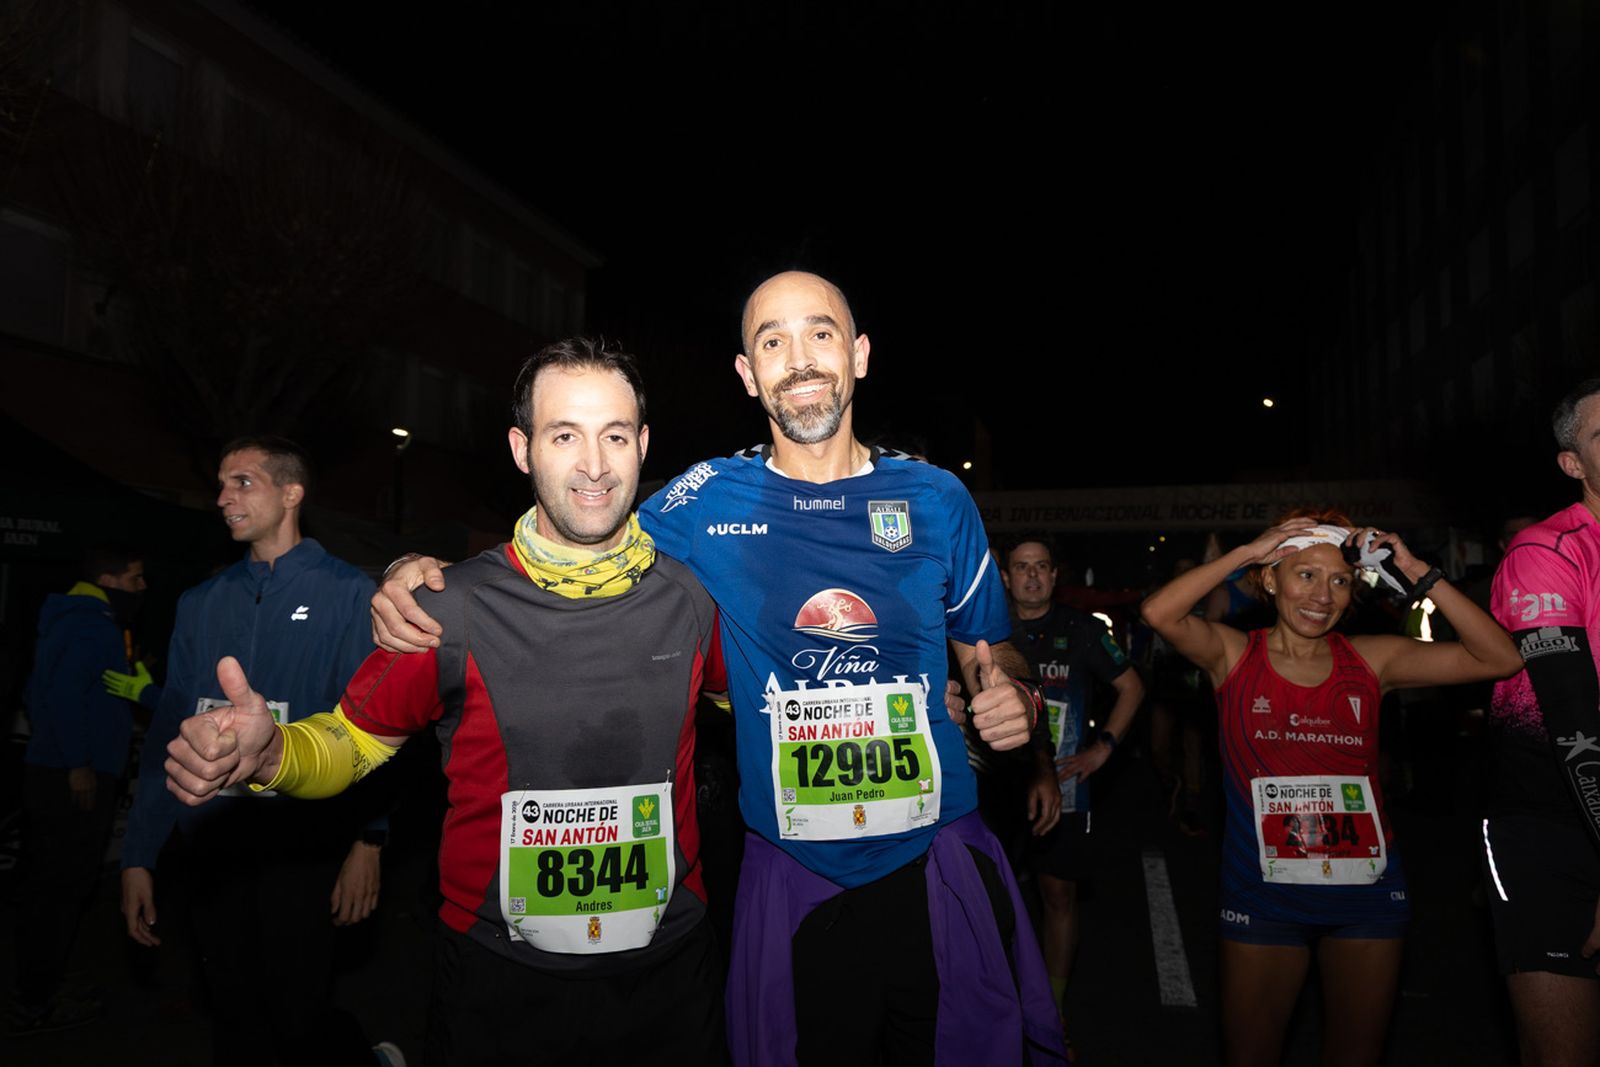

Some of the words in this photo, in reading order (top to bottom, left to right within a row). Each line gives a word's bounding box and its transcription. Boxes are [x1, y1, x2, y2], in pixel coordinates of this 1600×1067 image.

[690, 469, 719, 492] REAL
[794, 495, 845, 511] hummel
[1008, 504, 1163, 521] INTERNACIONAL
[1170, 503, 1238, 519] NOCHE
[1241, 502, 1268, 519] DE
[717, 523, 768, 535] UCLM
[791, 644, 880, 680] Viña
[786, 703, 800, 715] 43
[804, 704, 851, 720] NOCHE
[855, 703, 873, 717] DE
[788, 725, 817, 741] SAN
[820, 717, 875, 740] ANTÓN
[1254, 730, 1281, 740] A.D.
[1285, 731, 1363, 746] MARATHON
[791, 737, 920, 788] 12905
[830, 790, 854, 802] Juan
[857, 789, 885, 801] Pedro
[1280, 788, 1317, 799] NOCHE
[1319, 788, 1332, 798] DE
[523, 805, 539, 817] 43
[1268, 801, 1292, 812] SAN
[543, 808, 596, 824] NOCHE
[599, 806, 618, 821] DE
[522, 828, 557, 846] SAN
[560, 822, 618, 845] ANTÓN
[537, 843, 649, 898] 8344
[576, 900, 613, 912] Andres
